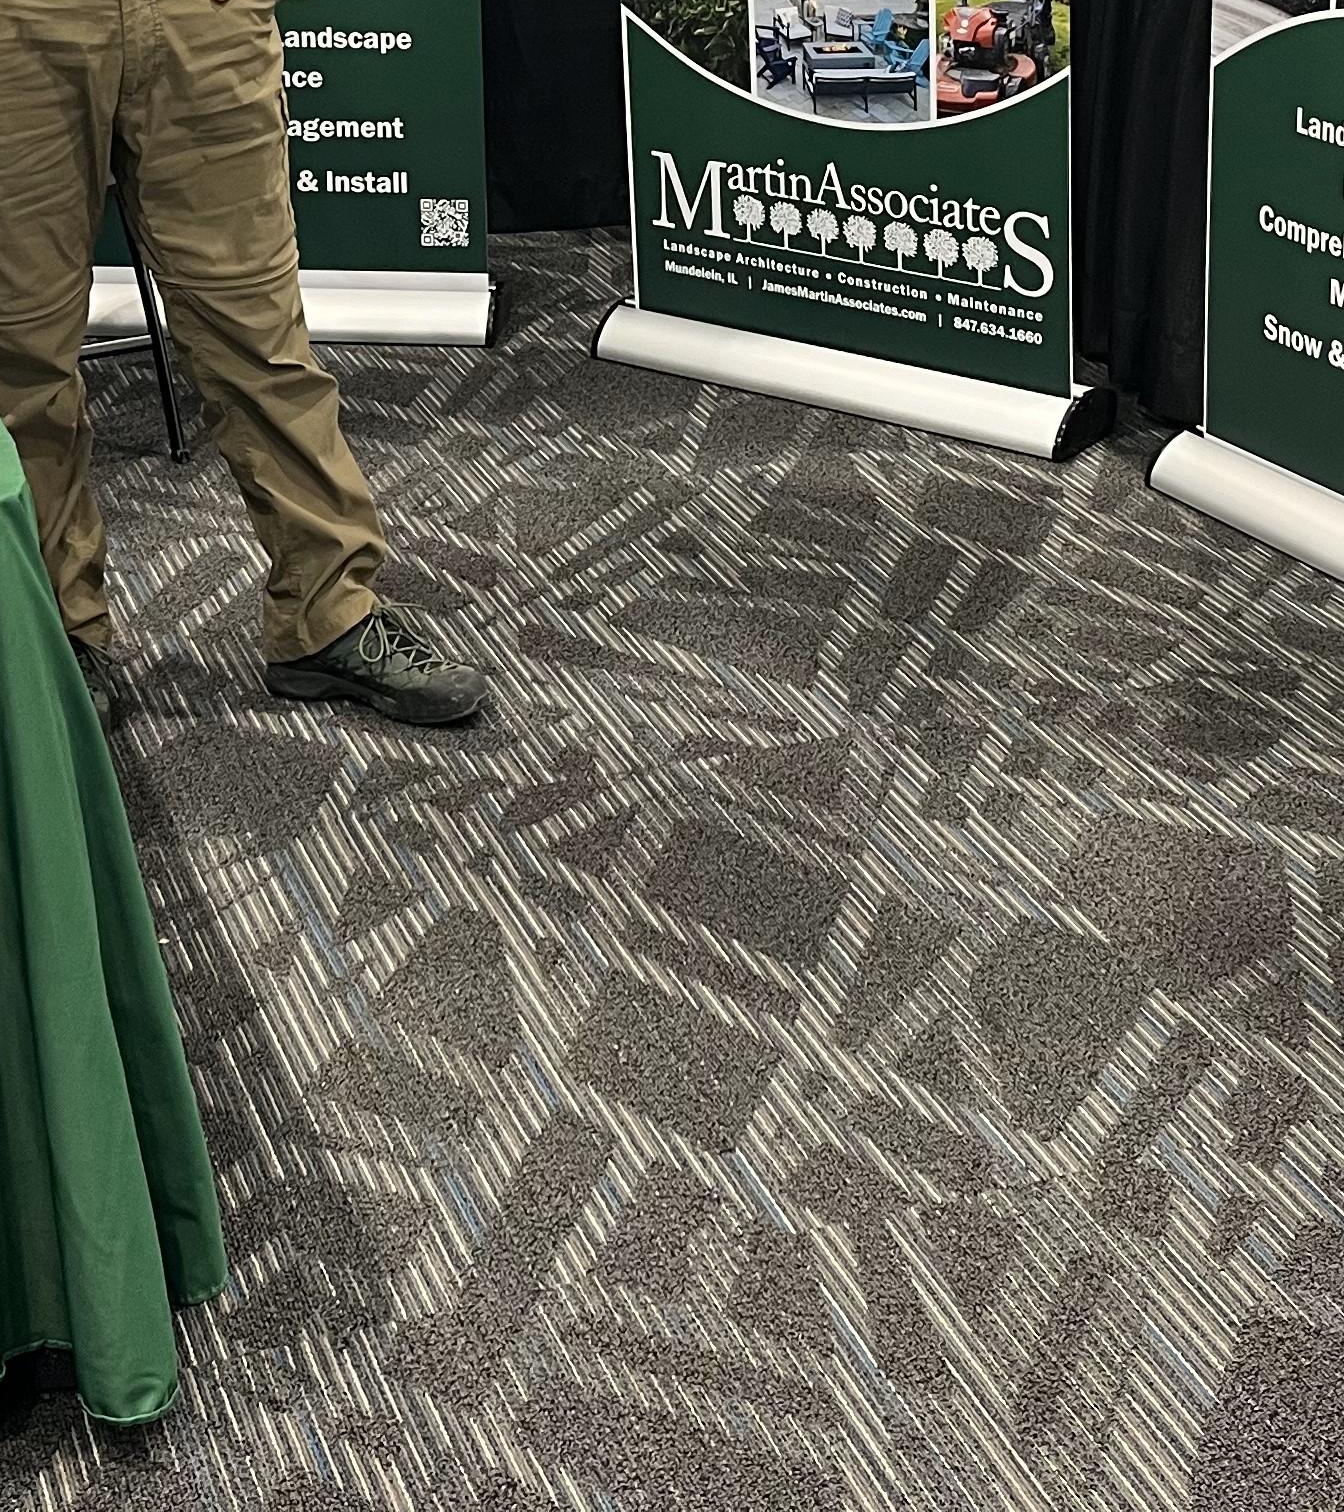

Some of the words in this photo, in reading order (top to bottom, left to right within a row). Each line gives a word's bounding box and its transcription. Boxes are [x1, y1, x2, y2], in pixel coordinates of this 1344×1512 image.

[282, 27, 412, 54] andscape
[296, 170, 319, 193] &
[327, 171, 408, 194] Install
[663, 239, 731, 263] Landscape
[735, 252, 820, 279] Architecture
[837, 272, 928, 301] Construction
[947, 293, 1044, 323] Maintenance
[665, 260, 726, 285] Mundelein,
[727, 273, 739, 285] IL
[761, 279, 927, 323] JamesMartinAssociates.com
[953, 316, 1043, 345] 847.634.1660
[1263, 314, 1323, 359] Snow
